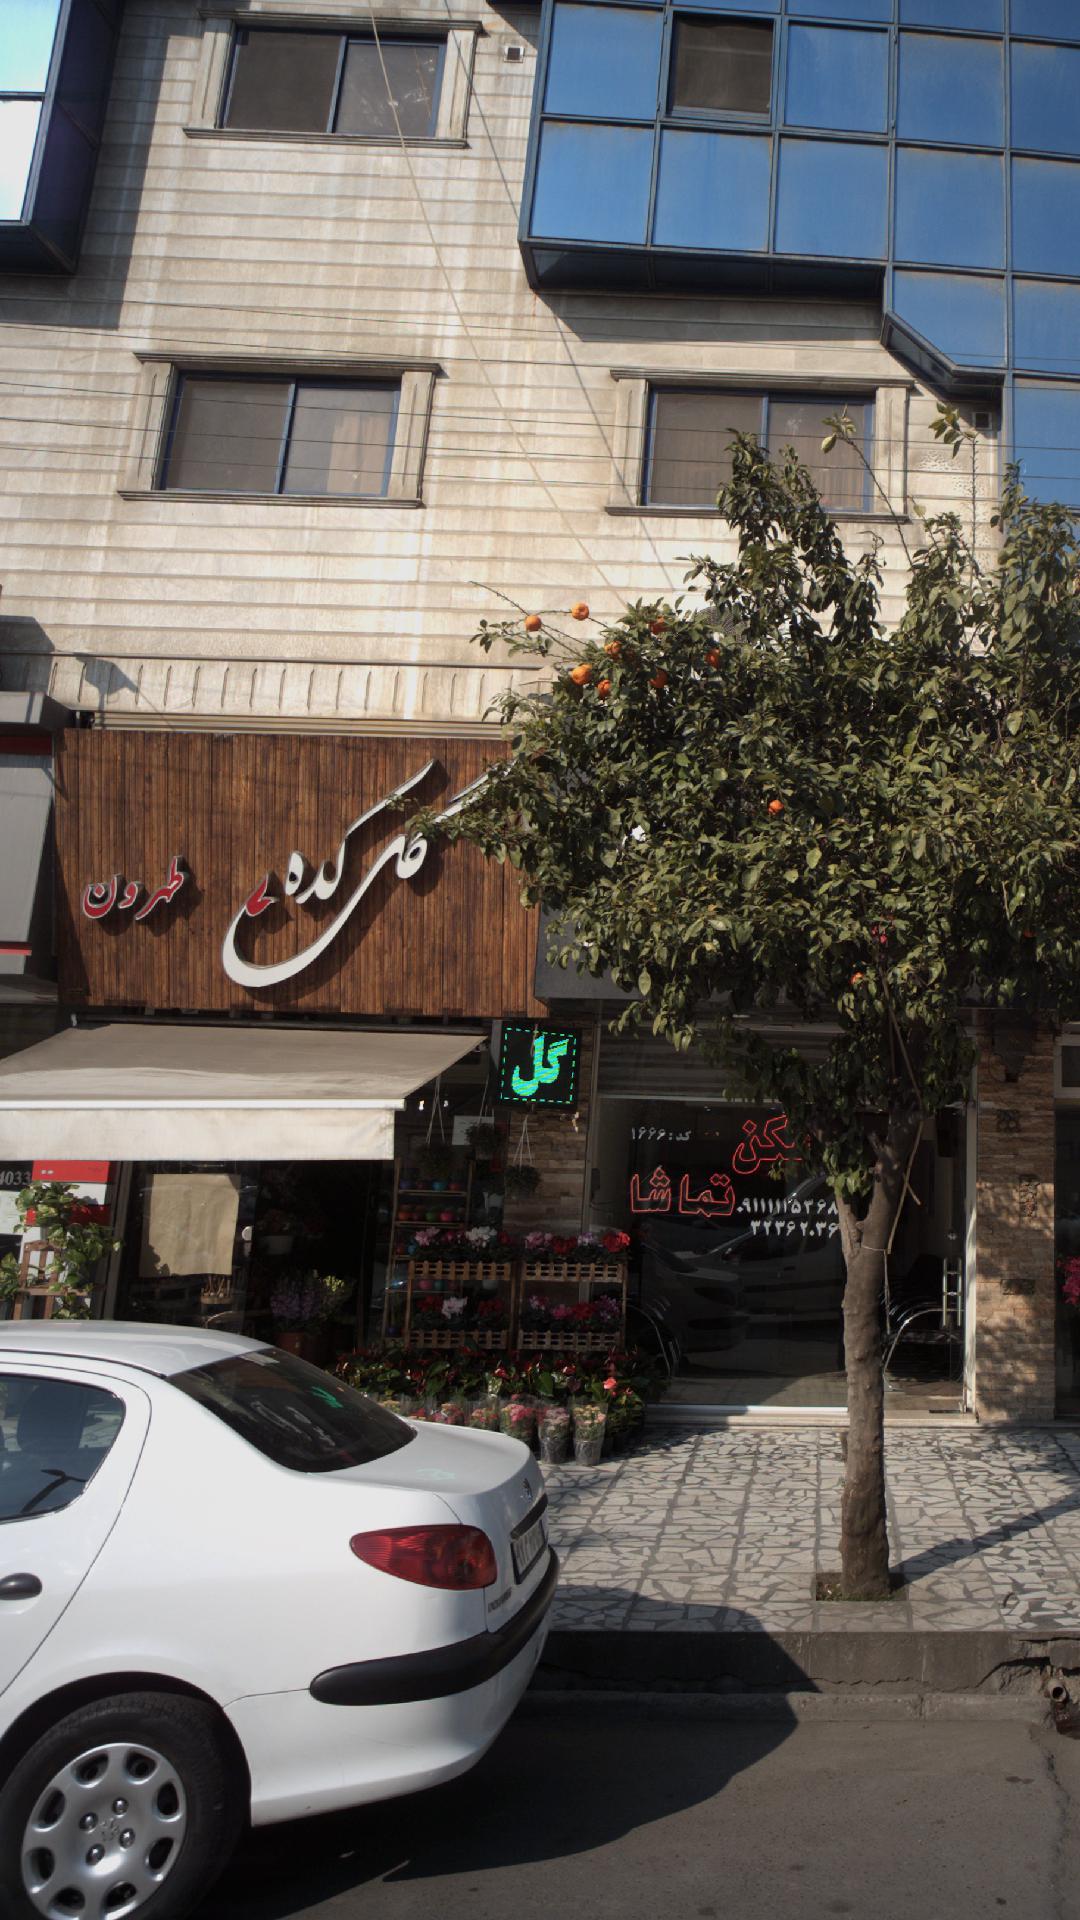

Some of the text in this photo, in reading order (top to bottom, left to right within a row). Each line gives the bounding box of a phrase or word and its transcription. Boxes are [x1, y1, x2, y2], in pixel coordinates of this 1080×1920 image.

[82, 854, 186, 920] طهرون
[511, 1034, 569, 1096] گل
[629, 1165, 736, 1217] تماشا
